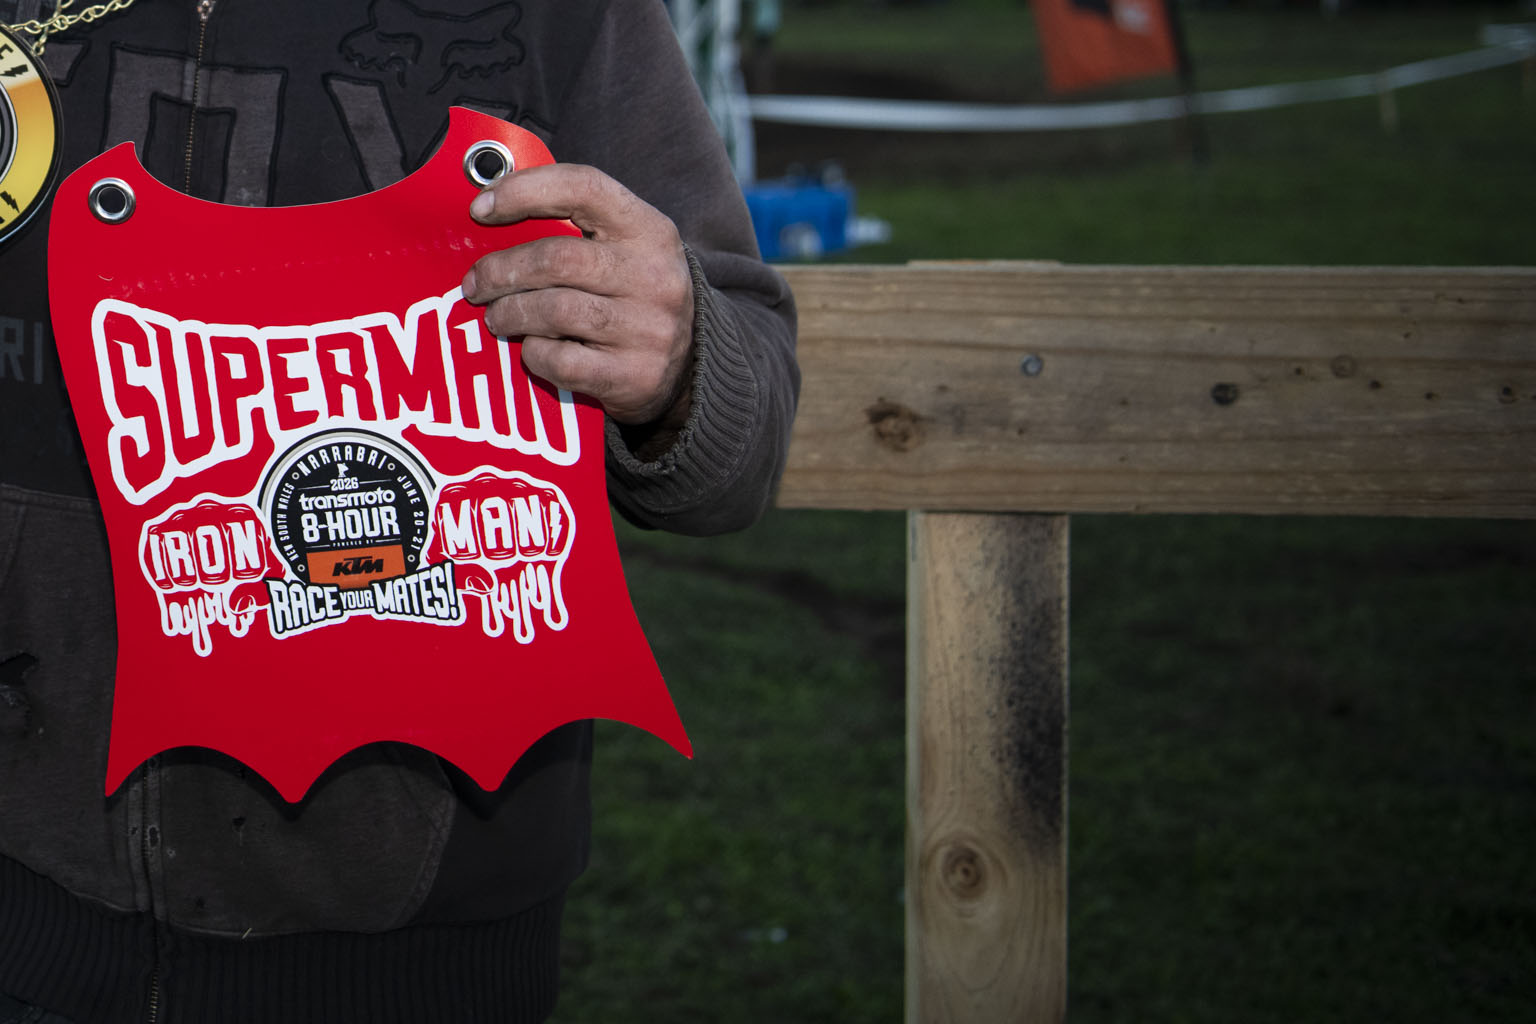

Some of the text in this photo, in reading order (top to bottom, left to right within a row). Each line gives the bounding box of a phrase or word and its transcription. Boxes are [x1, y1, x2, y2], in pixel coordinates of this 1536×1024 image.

[96, 288, 576, 502] SUPERMAN
[296, 445, 388, 477] NARRABRI
[330, 477, 359, 491] 2026
[276, 482, 299, 562] NEW SOUTH WALES
[298, 486, 396, 511] transmoto
[397, 475, 425, 550] JUNE 20-21
[300, 505, 401, 543] 8-HOUR
[151, 520, 263, 582] IRON
[332, 555, 384, 577] KTM
[266, 561, 460, 633] RACE YOUR MATES!
